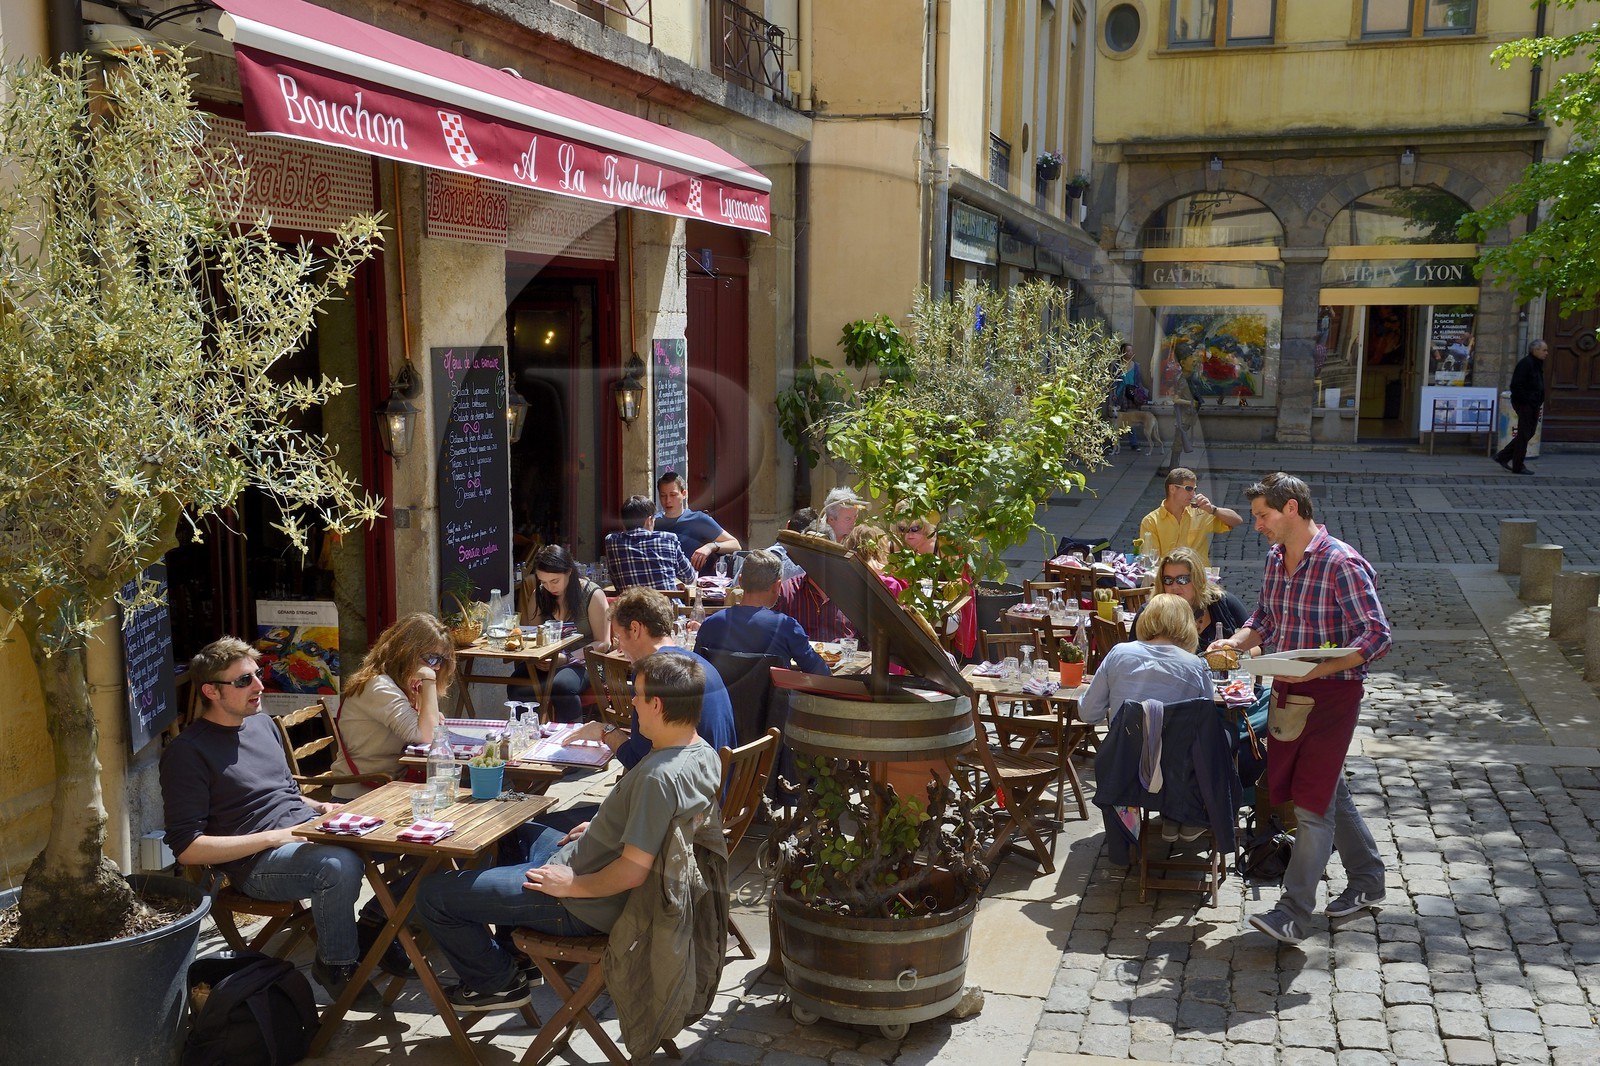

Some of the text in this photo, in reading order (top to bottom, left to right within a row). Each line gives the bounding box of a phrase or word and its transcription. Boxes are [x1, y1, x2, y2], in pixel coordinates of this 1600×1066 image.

[277, 73, 767, 224] Bouchon A La Traboule Lyonnais
[429, 172, 508, 231] Bouchon
[1341, 266, 1401, 282] VIEUX
[1415, 264, 1464, 281] LYON
[464, 351, 470, 369] de
[473, 352, 480, 369] la
[450, 380, 470, 397] Salade
